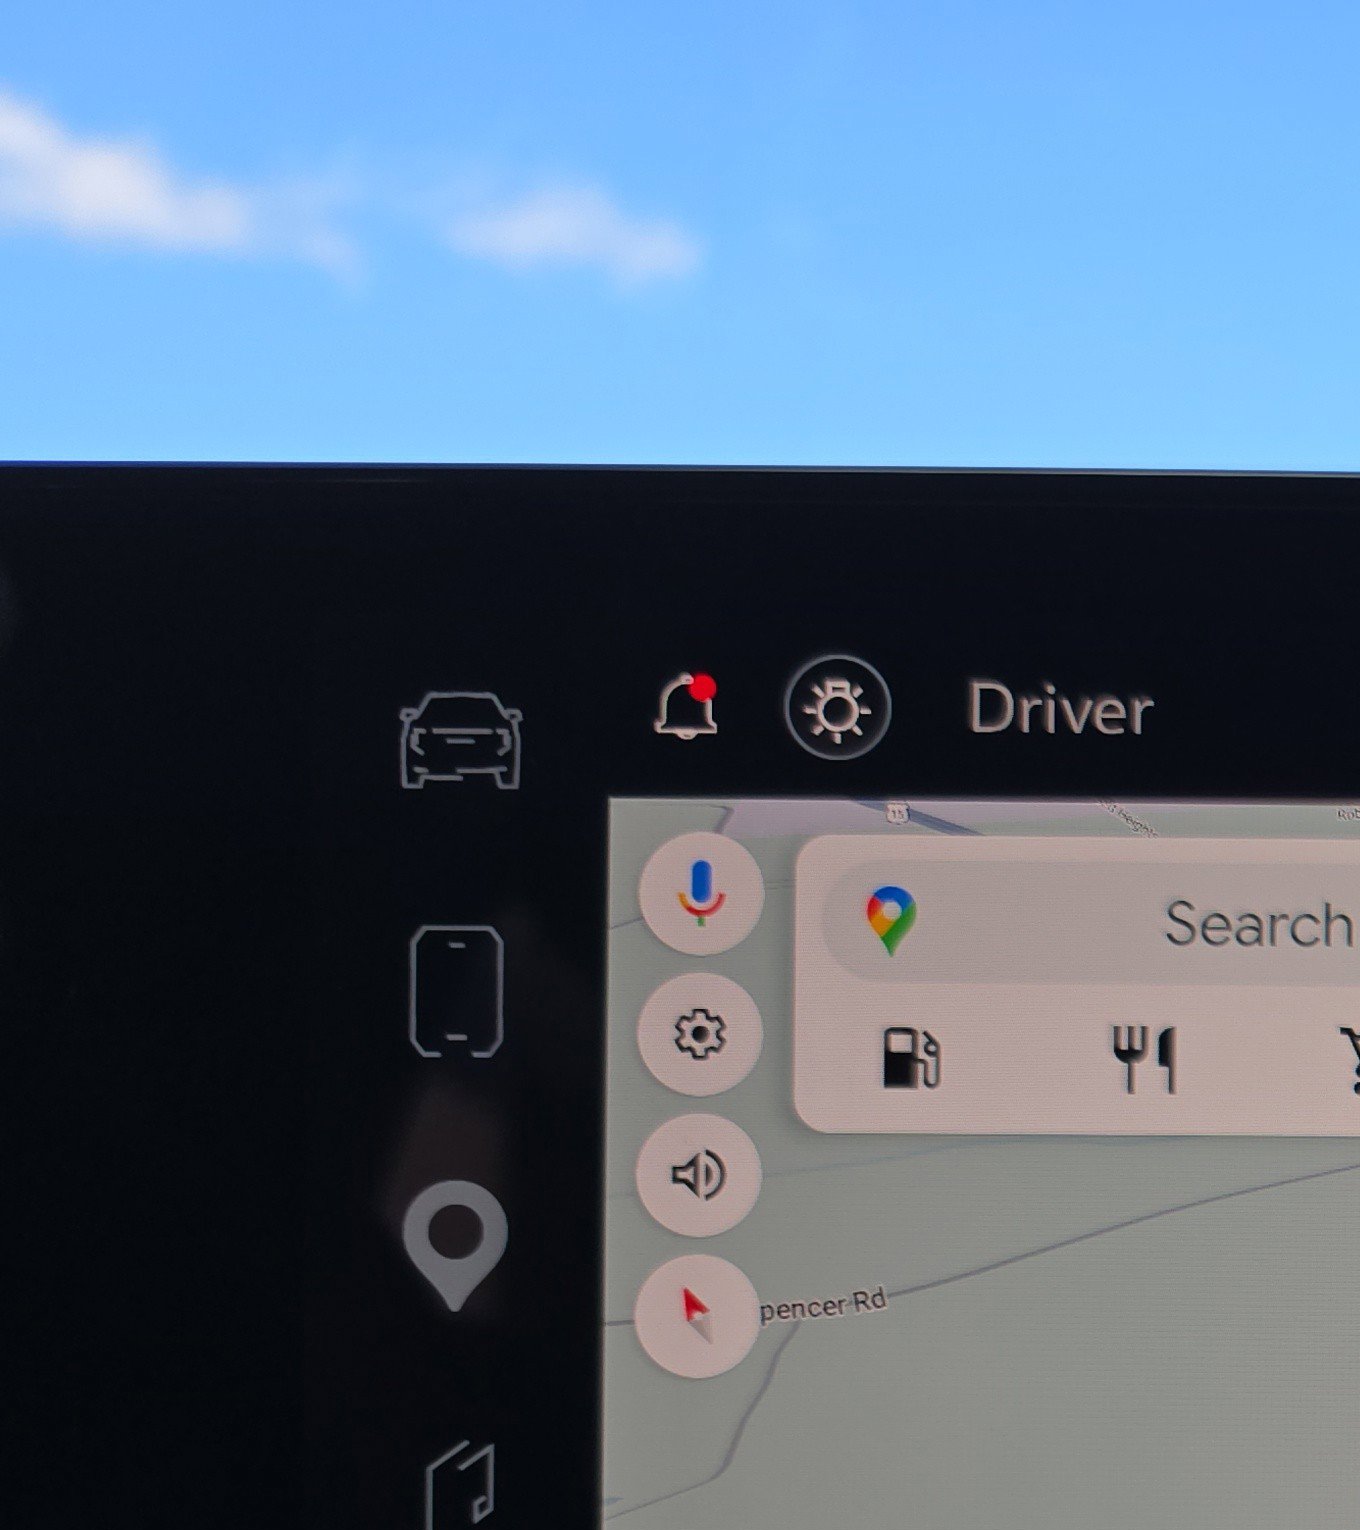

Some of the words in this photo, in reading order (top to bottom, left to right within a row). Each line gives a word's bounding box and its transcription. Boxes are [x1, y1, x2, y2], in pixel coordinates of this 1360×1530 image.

[969, 678, 1155, 735] Driver
[1165, 900, 1354, 948] Search
[760, 1296, 848, 1324] pencer
[853, 1286, 887, 1311] Rd
